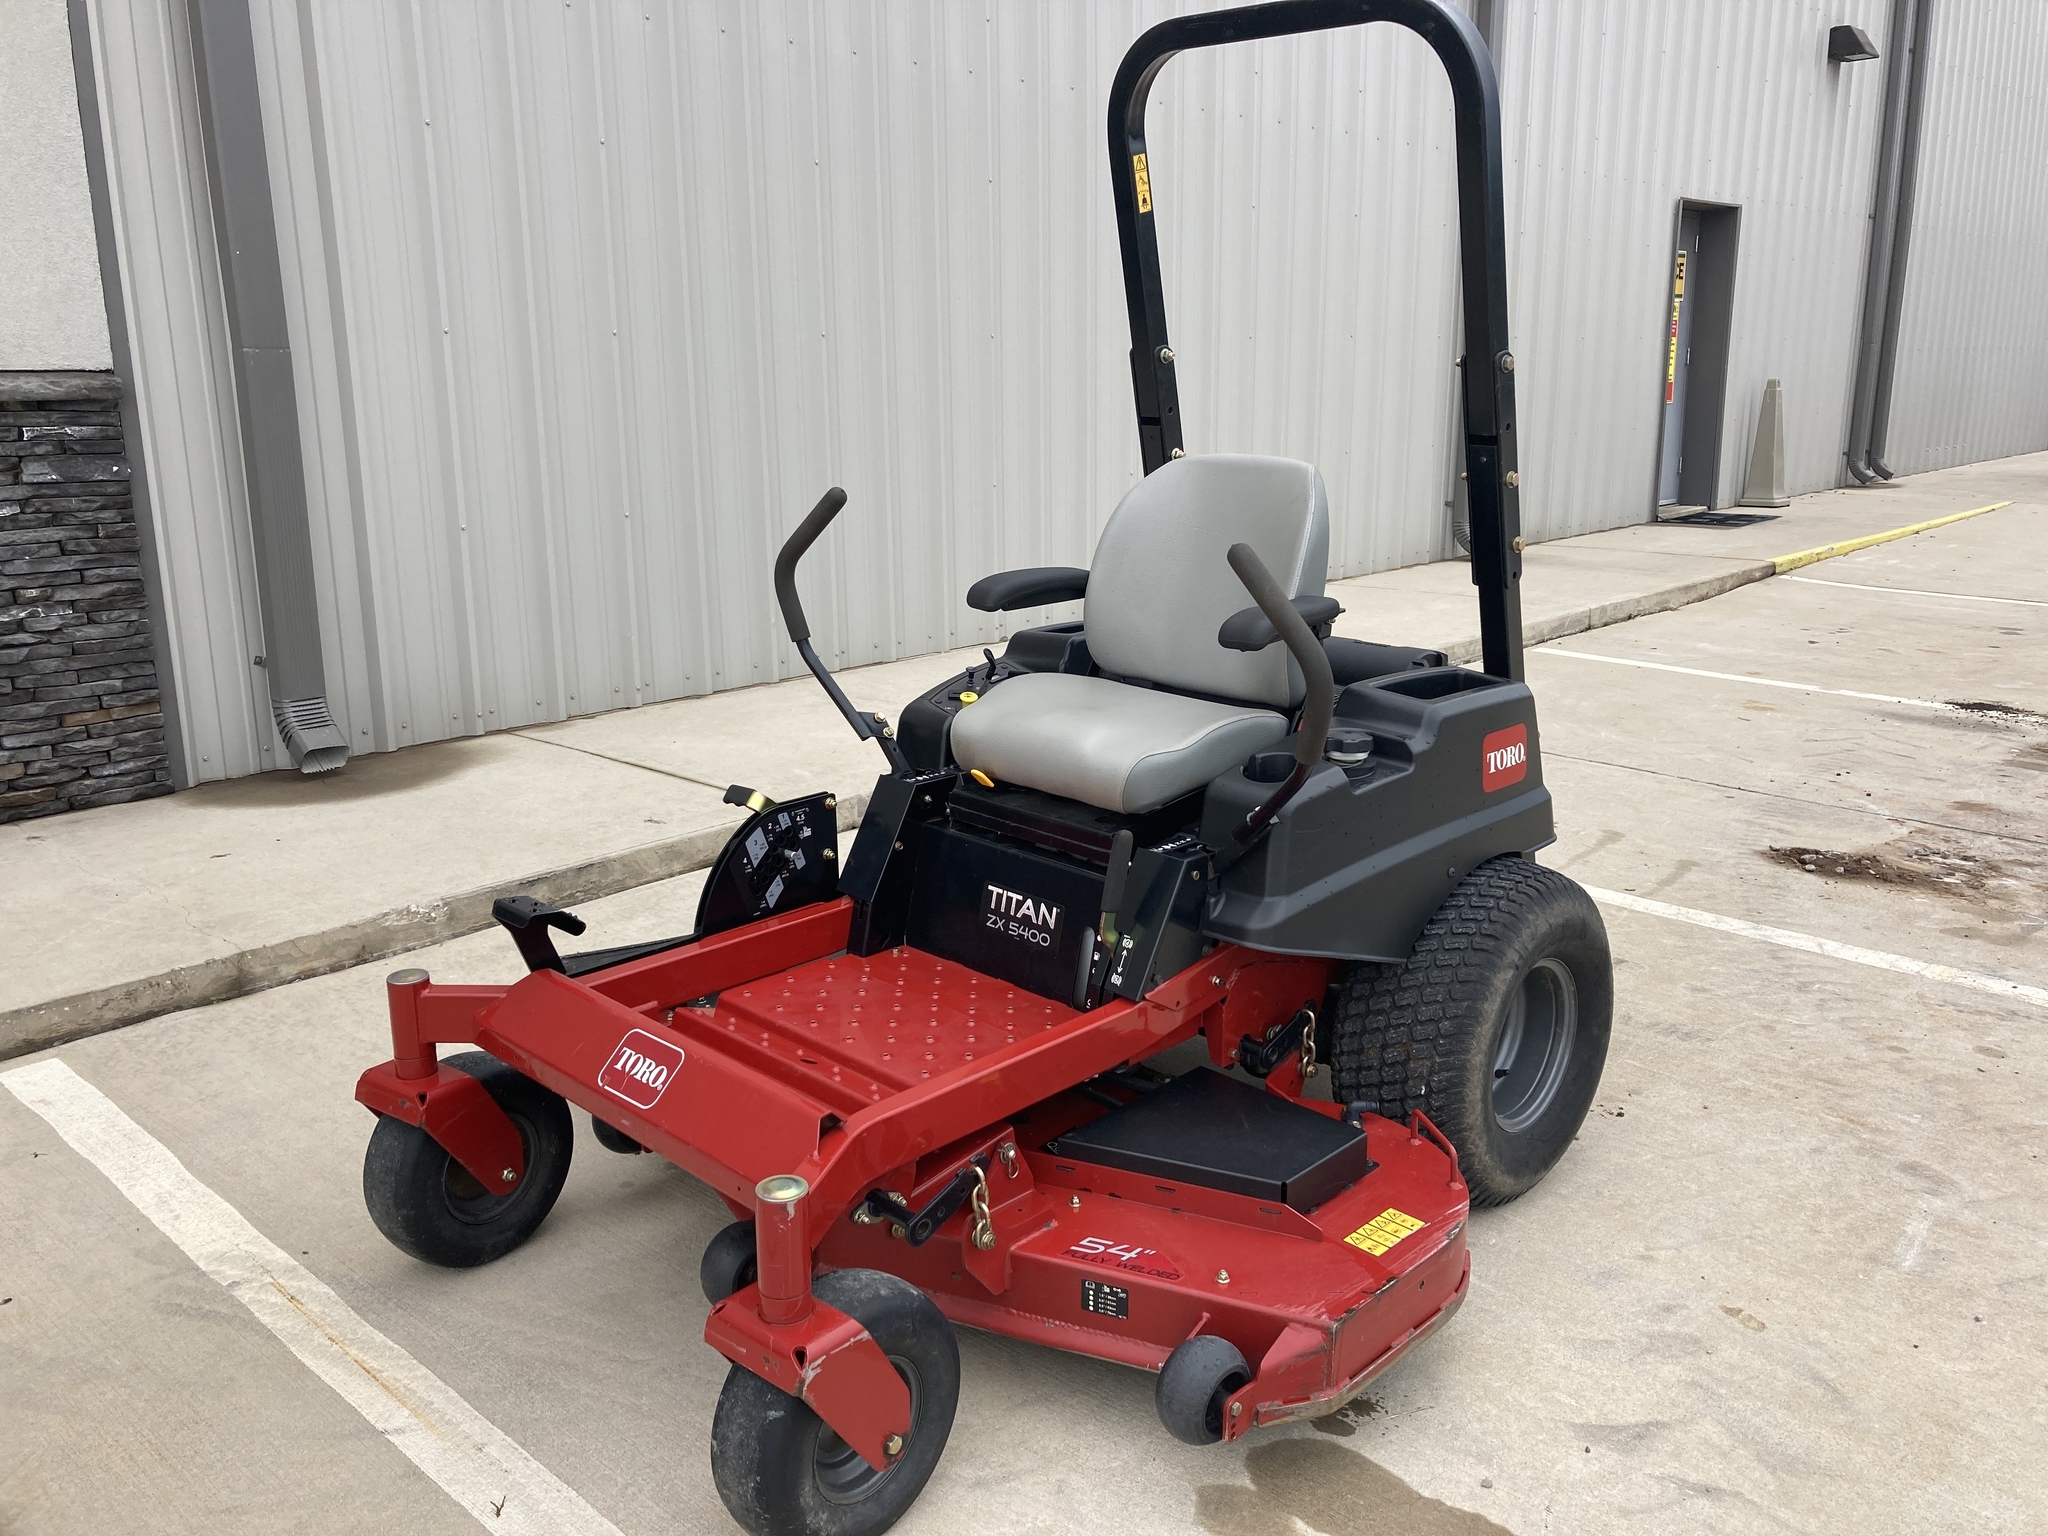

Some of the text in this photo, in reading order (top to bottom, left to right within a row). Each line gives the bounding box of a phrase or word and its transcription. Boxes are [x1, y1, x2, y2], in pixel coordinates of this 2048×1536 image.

[1486, 742, 1525, 774] TORO
[987, 884, 1058, 930] TITAN
[985, 913, 1051, 947] ZX 5400
[613, 1046, 668, 1088] TORO
[1061, 1249, 1180, 1281] FULLY WELDED
